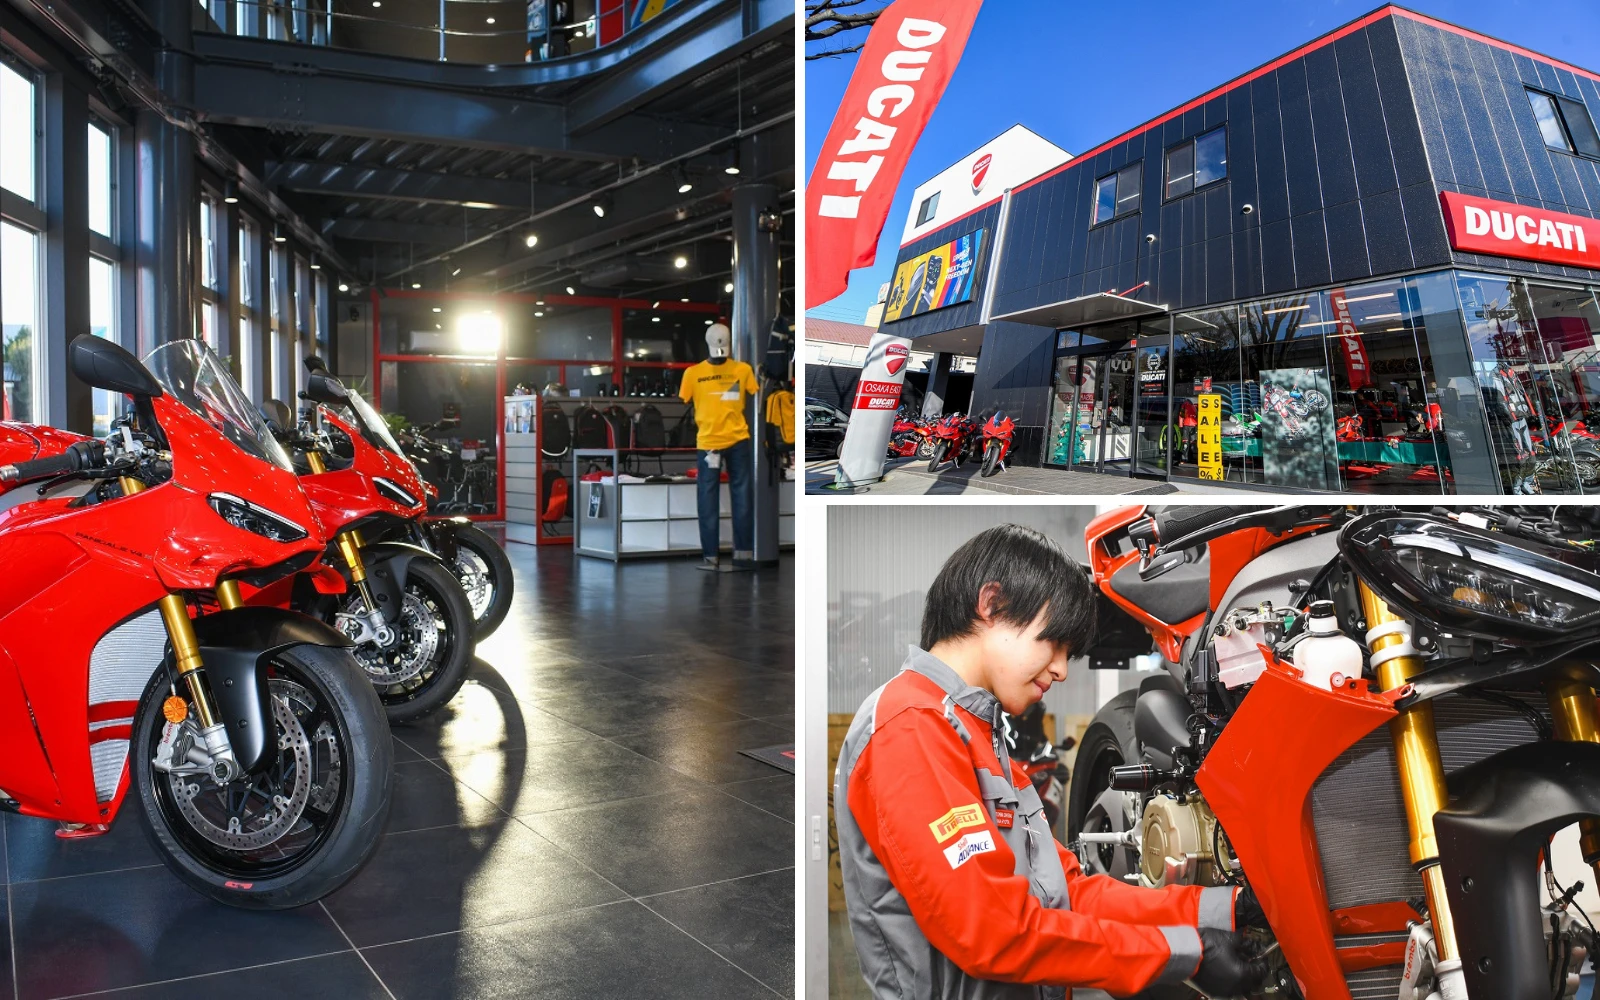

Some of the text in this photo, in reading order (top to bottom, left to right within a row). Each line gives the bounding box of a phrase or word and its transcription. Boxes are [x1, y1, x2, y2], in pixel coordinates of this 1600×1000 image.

[818, 17, 947, 219] DUCATI
[1464, 205, 1587, 253] DUCATI
[1334, 296, 1365, 371] DUCATI
[888, 346, 908, 355] DUCATI
[865, 383, 889, 393] OSAKA
[1141, 373, 1166, 381] DUCATI
[869, 397, 896, 406] DUCATI
[1201, 399, 1210, 462] SALE
[937, 808, 979, 836] PIRELLI
[957, 837, 969, 851] Shell
[957, 840, 990, 865] ADVANCE
[1404, 938, 1416, 980] brembo
